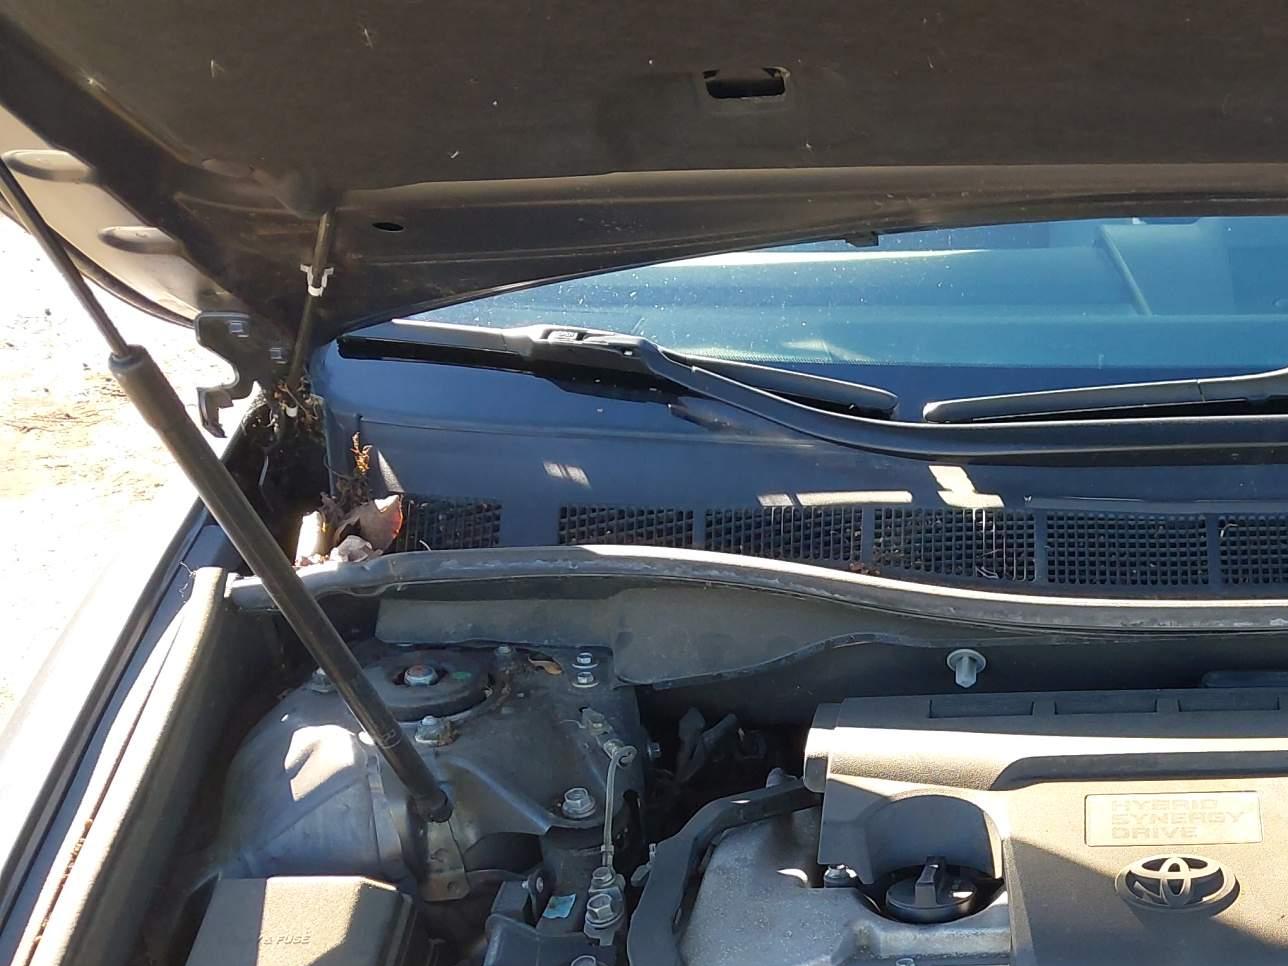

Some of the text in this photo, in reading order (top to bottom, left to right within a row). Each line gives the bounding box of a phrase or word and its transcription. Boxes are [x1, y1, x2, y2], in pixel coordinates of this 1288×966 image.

[1111, 799, 1218, 811] HYBRID
[1111, 811, 1246, 825] SYNERGY
[1111, 826, 1198, 840] DRIVE
[275, 935, 311, 945] FUSE
